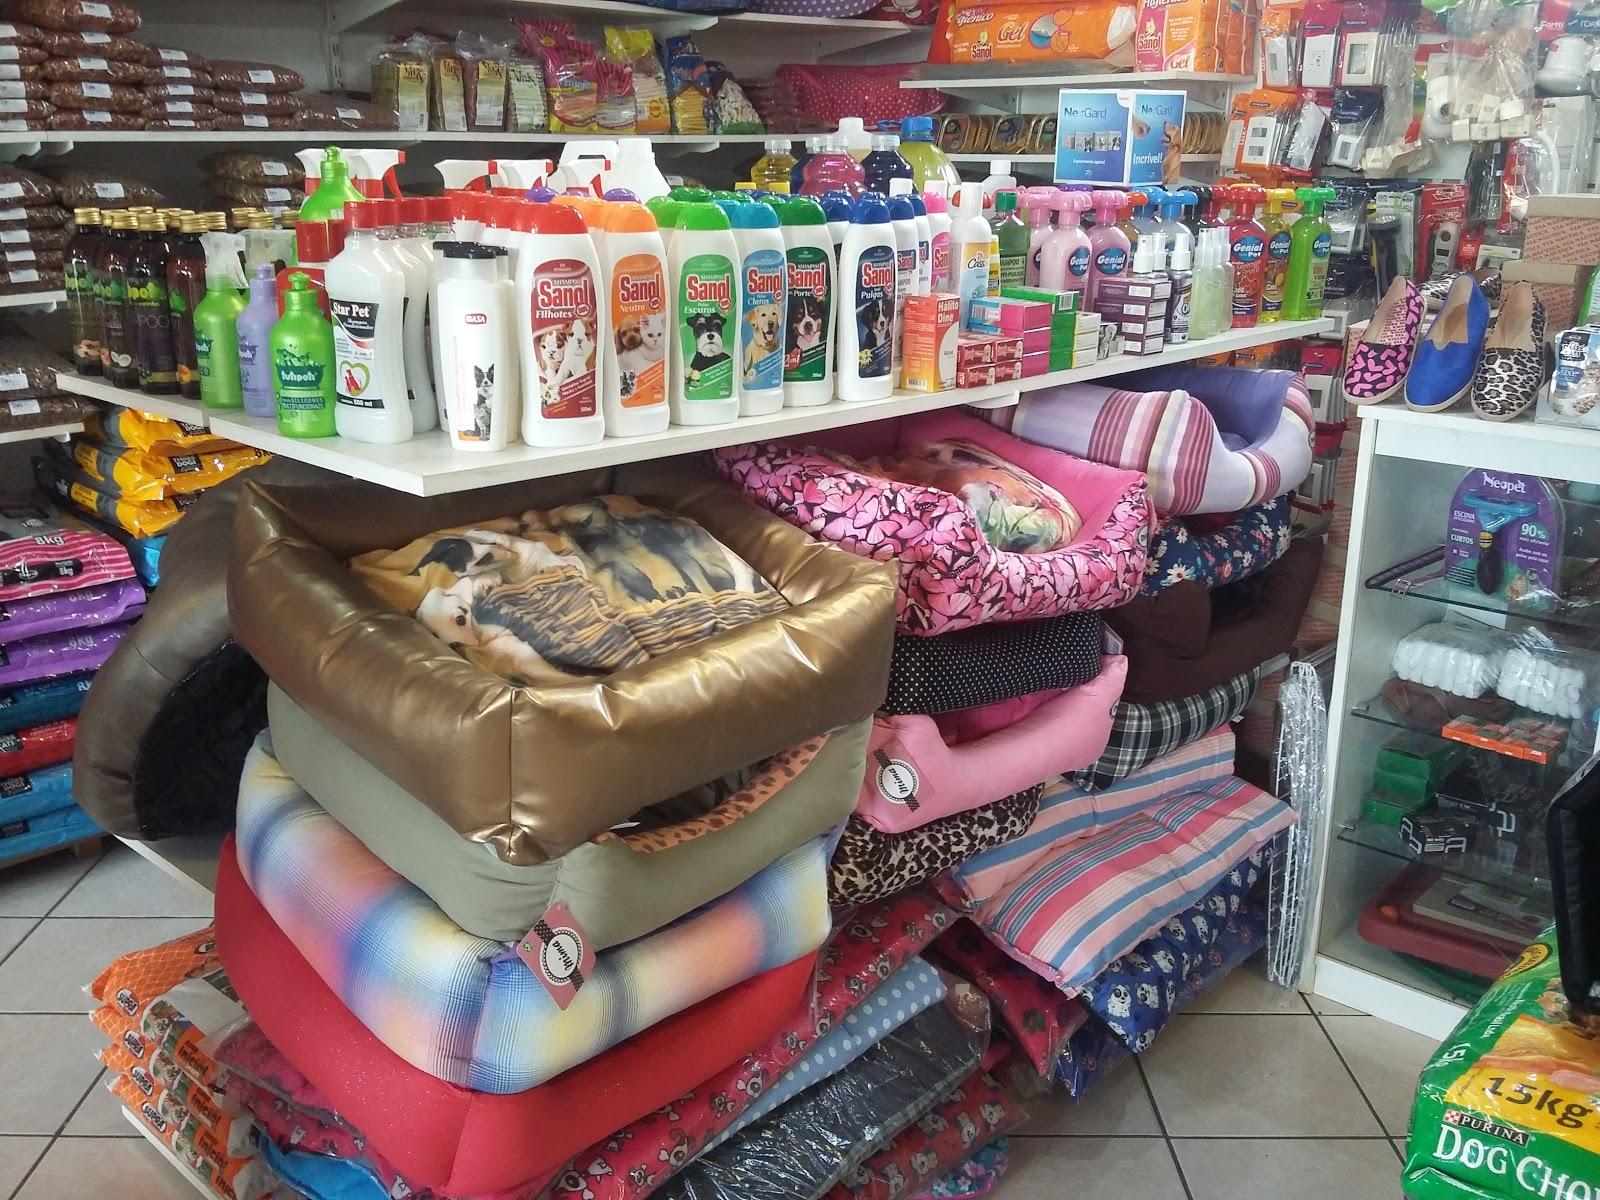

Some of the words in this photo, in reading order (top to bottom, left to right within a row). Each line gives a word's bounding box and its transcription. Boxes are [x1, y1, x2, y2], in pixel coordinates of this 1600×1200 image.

[997, 21, 1028, 43] Gel
[1234, 242, 1264, 252] Genial
[1270, 240, 1291, 249] Genial
[1098, 254, 1126, 264] Genial
[748, 267, 783, 295] Sanol
[862, 261, 893, 288] Sanol
[538, 278, 589, 309] Sanol
[619, 272, 660, 303] Sanol
[687, 273, 731, 302] Sanol
[793, 289, 812, 297] Porte
[861, 291, 883, 301] Pulgas
[333, 302, 350, 315] Star
[351, 304, 370, 318] Pet
[619, 304, 645, 313] Neutro
[684, 305, 716, 314] Escuros
[748, 297, 770, 305] Claros
[536, 310, 573, 319] Filhotes
[1482, 472, 1528, 494] Neopet
[1453, 510, 1475, 520] ESCOVA
[35, 535, 65, 546] 8kg
[1450, 533, 1474, 545] CURTOS
[1521, 524, 1546, 539] 90%
[117, 992, 138, 1013] SUPRA
[126, 1033, 144, 1055] SUPRA
[132, 1070, 153, 1094] SUPRA
[1482, 1076, 1594, 1130] 15kg
[143, 1105, 166, 1132] SUPRA
[1461, 1115, 1525, 1146] PURINA
[1433, 1123, 1508, 1175] DOG
[1515, 1155, 1600, 1200] CHO
